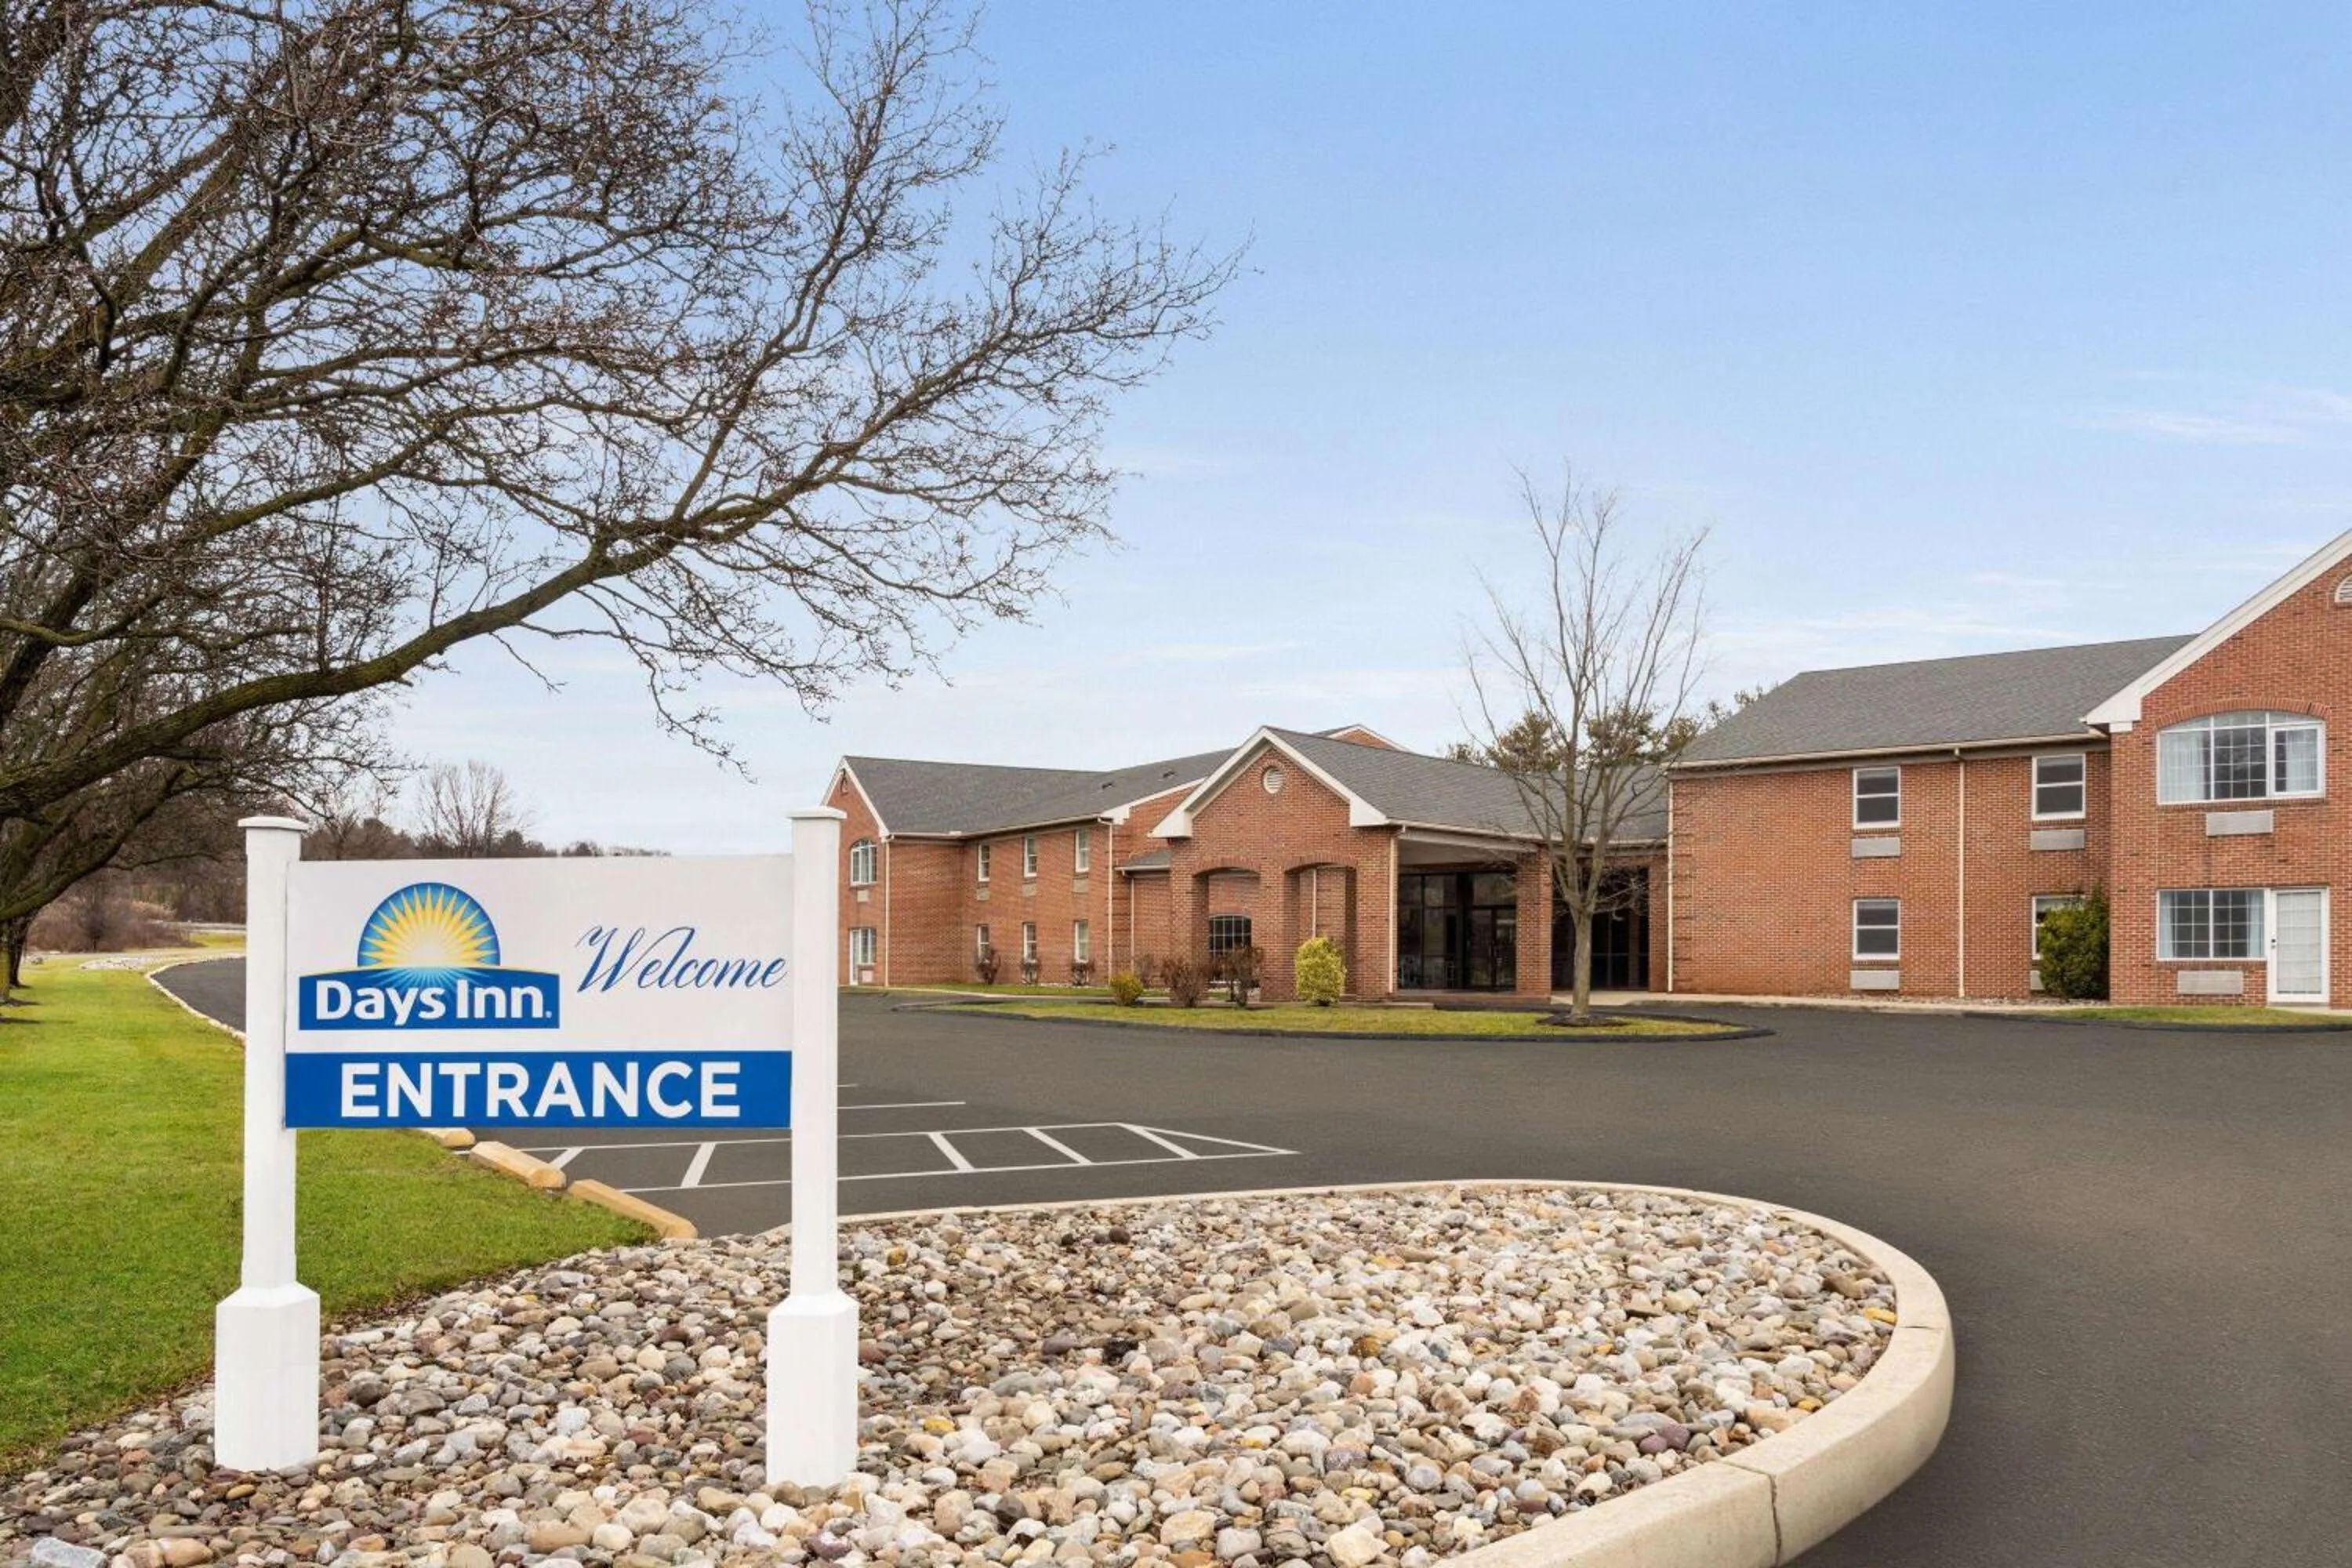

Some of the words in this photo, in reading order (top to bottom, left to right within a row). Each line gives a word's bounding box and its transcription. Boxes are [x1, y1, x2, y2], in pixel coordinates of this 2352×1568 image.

[576, 925, 787, 993] Welcome
[316, 981, 445, 1025] Days
[340, 1062, 741, 1119] ENTRANCE
